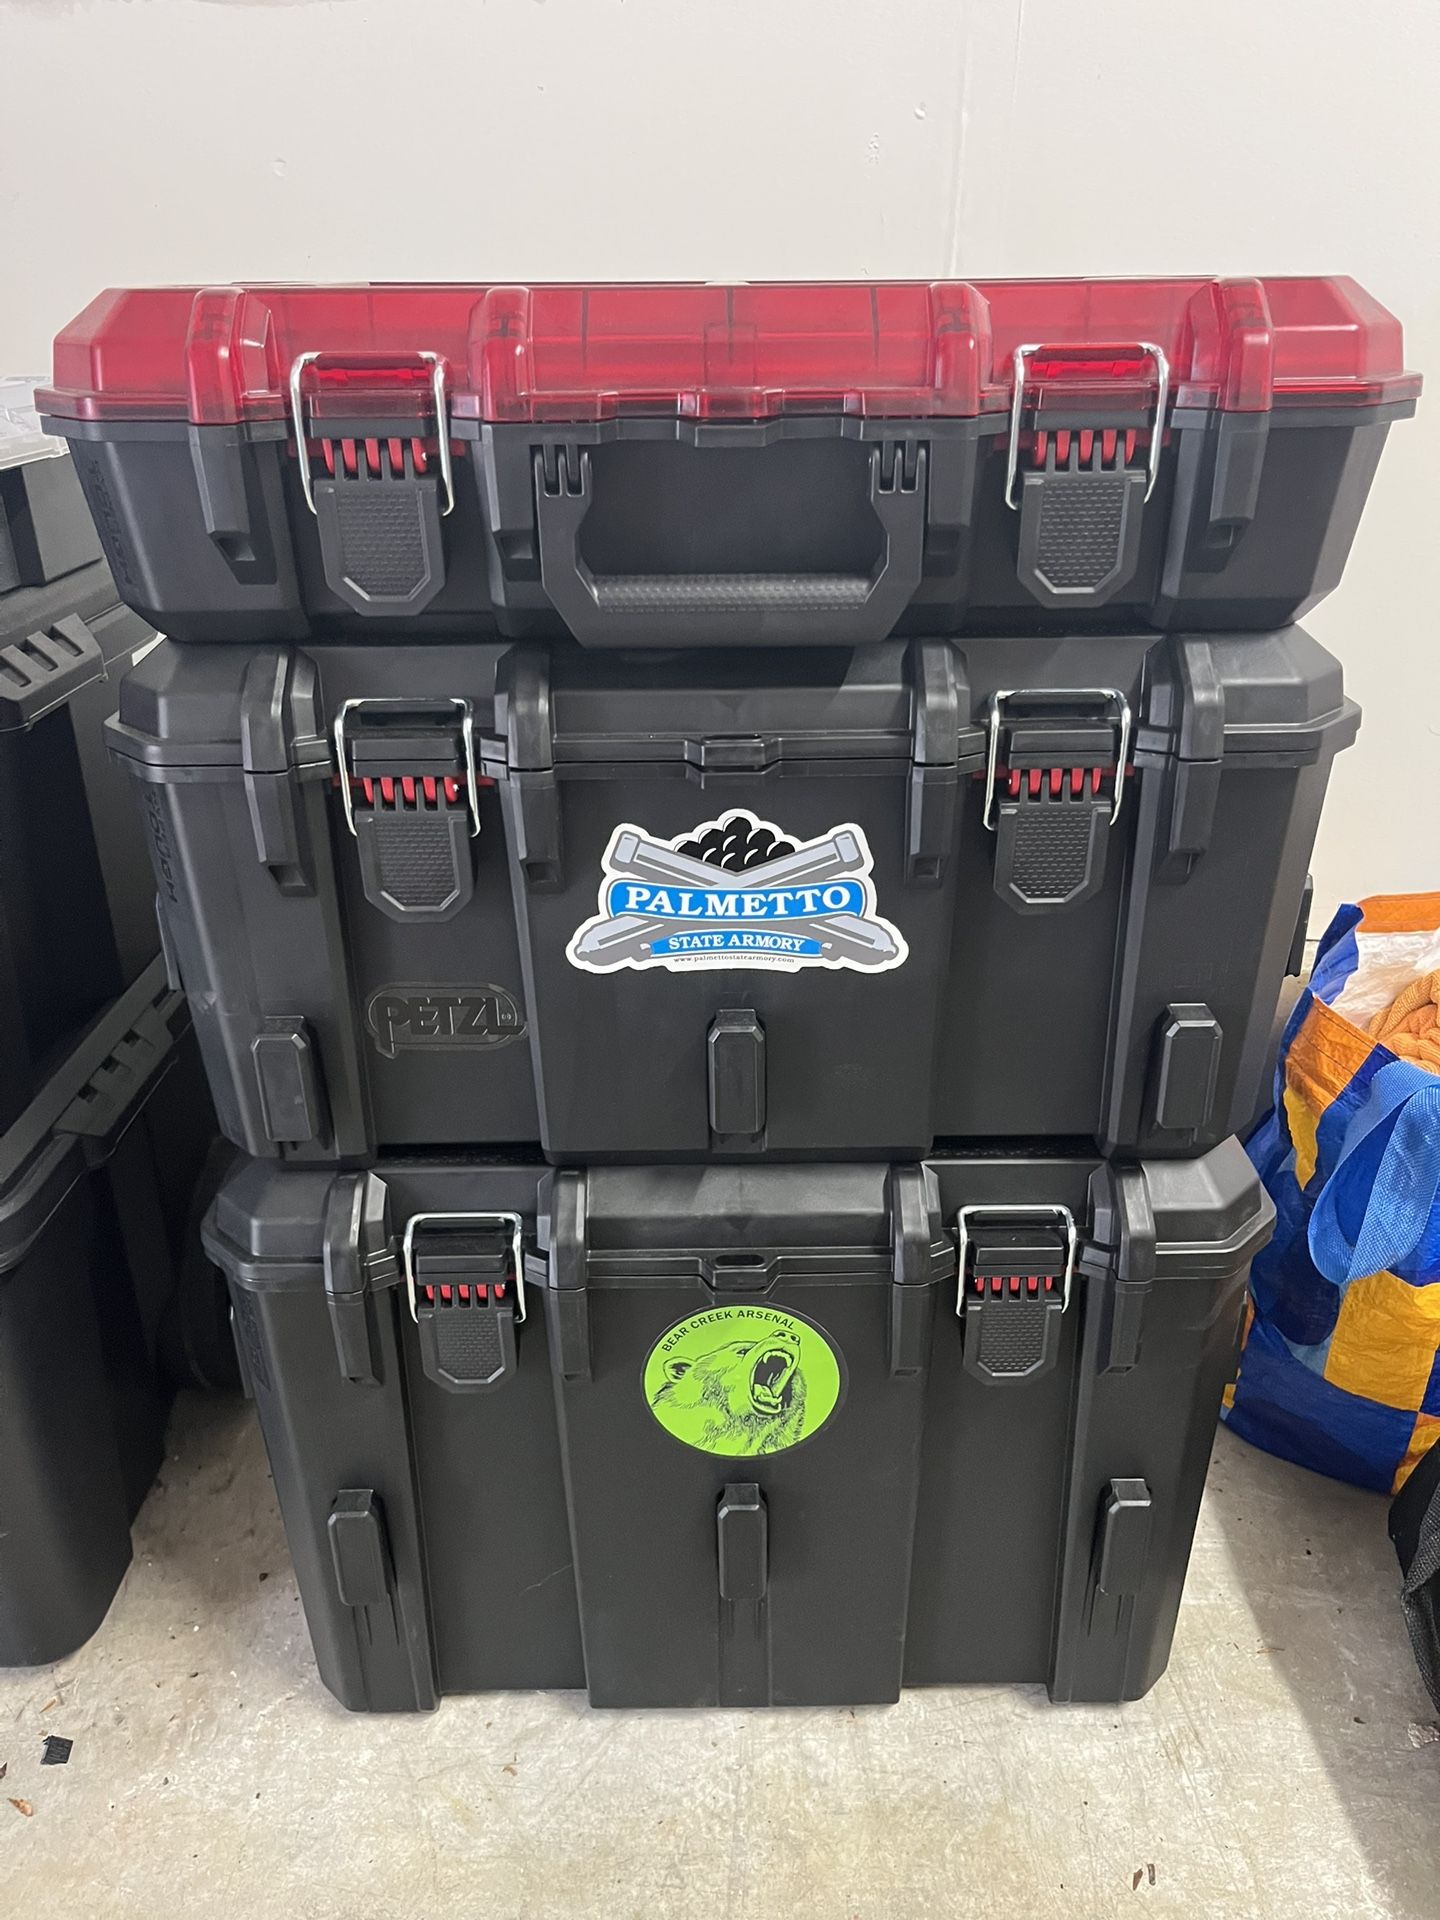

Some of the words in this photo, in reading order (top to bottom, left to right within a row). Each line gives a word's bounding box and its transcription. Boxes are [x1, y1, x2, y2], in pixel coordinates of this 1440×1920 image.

[625, 886, 851, 917] PALMETTO
[668, 934, 725, 950] STATE
[728, 934, 806, 951] ARMORY
[673, 955, 796, 963] www.palmettostatearmory.com
[374, 996, 527, 1055] PETZL
[661, 1327, 690, 1352] BEAR
[690, 1310, 733, 1329] CREEK
[737, 1309, 796, 1330] ARSENAL
